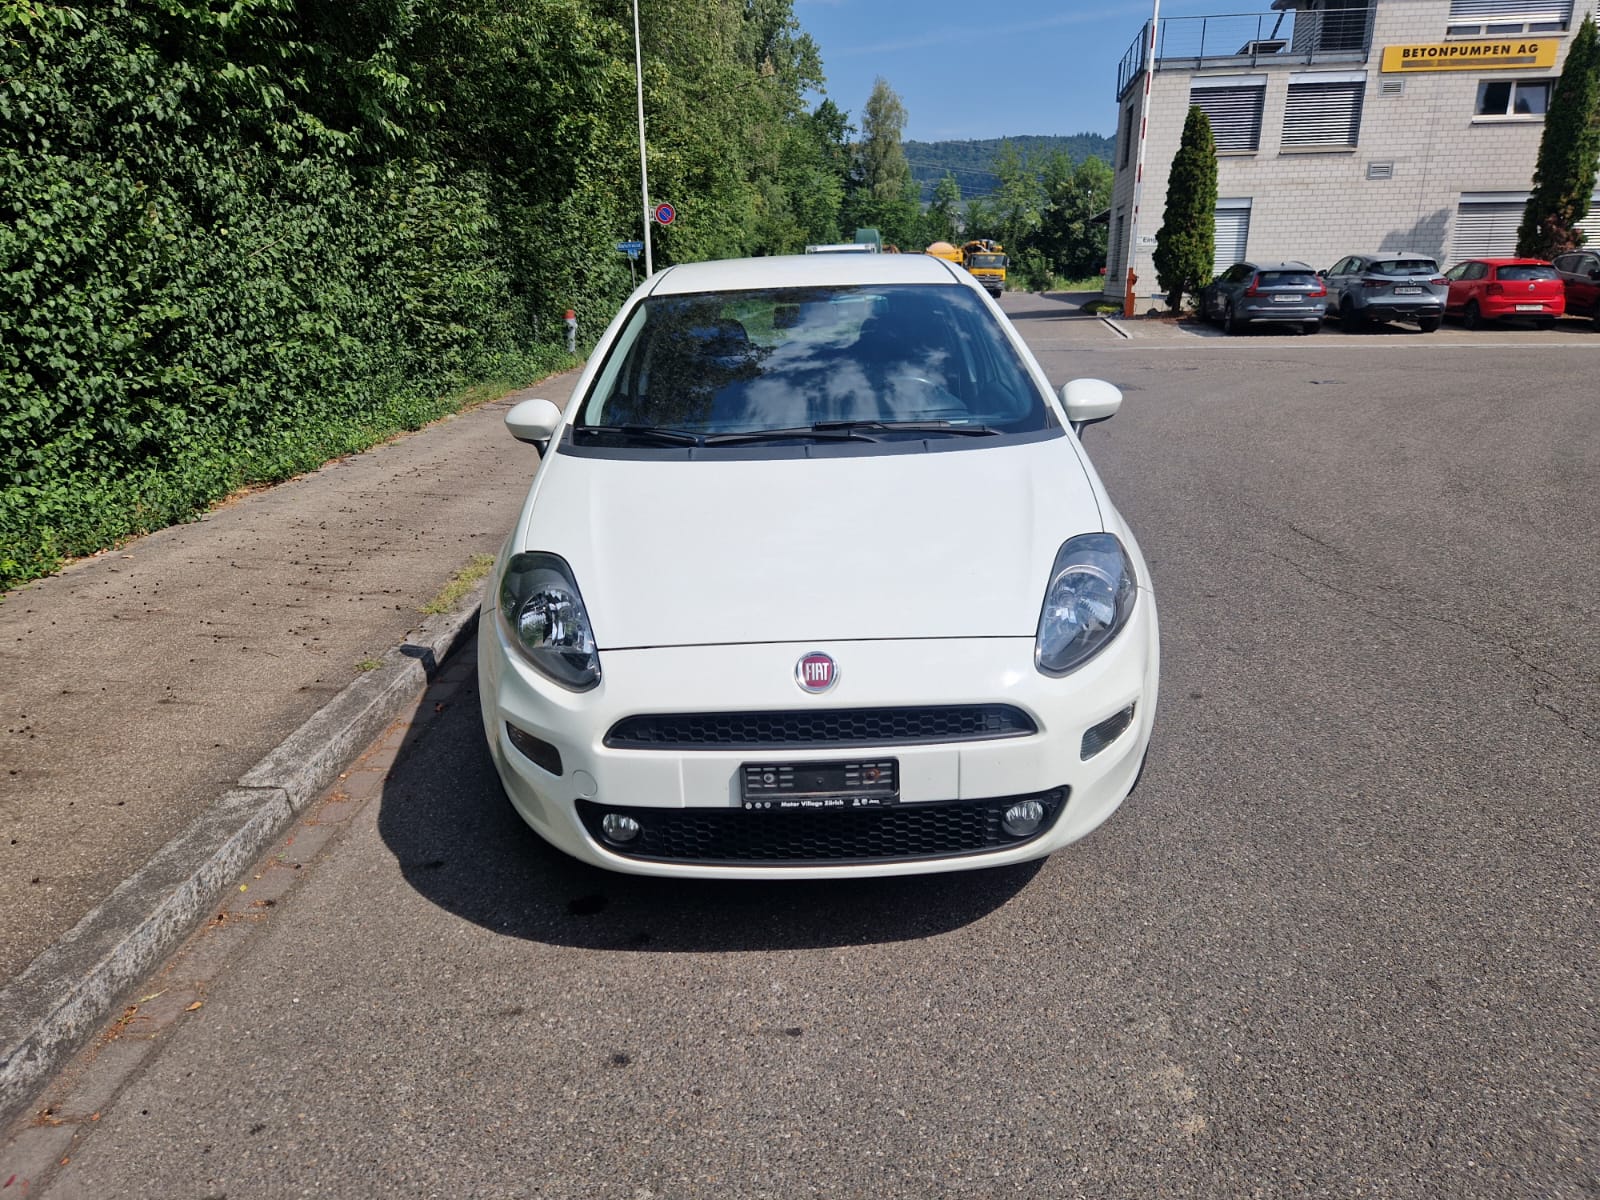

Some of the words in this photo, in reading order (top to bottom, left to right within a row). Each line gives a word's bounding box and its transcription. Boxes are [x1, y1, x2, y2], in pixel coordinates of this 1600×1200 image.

[1402, 44, 1511, 58] BETONPUMPEN
[1517, 43, 1539, 54] AG
[805, 662, 829, 681] FIAT
[801, 800, 823, 808] Village
